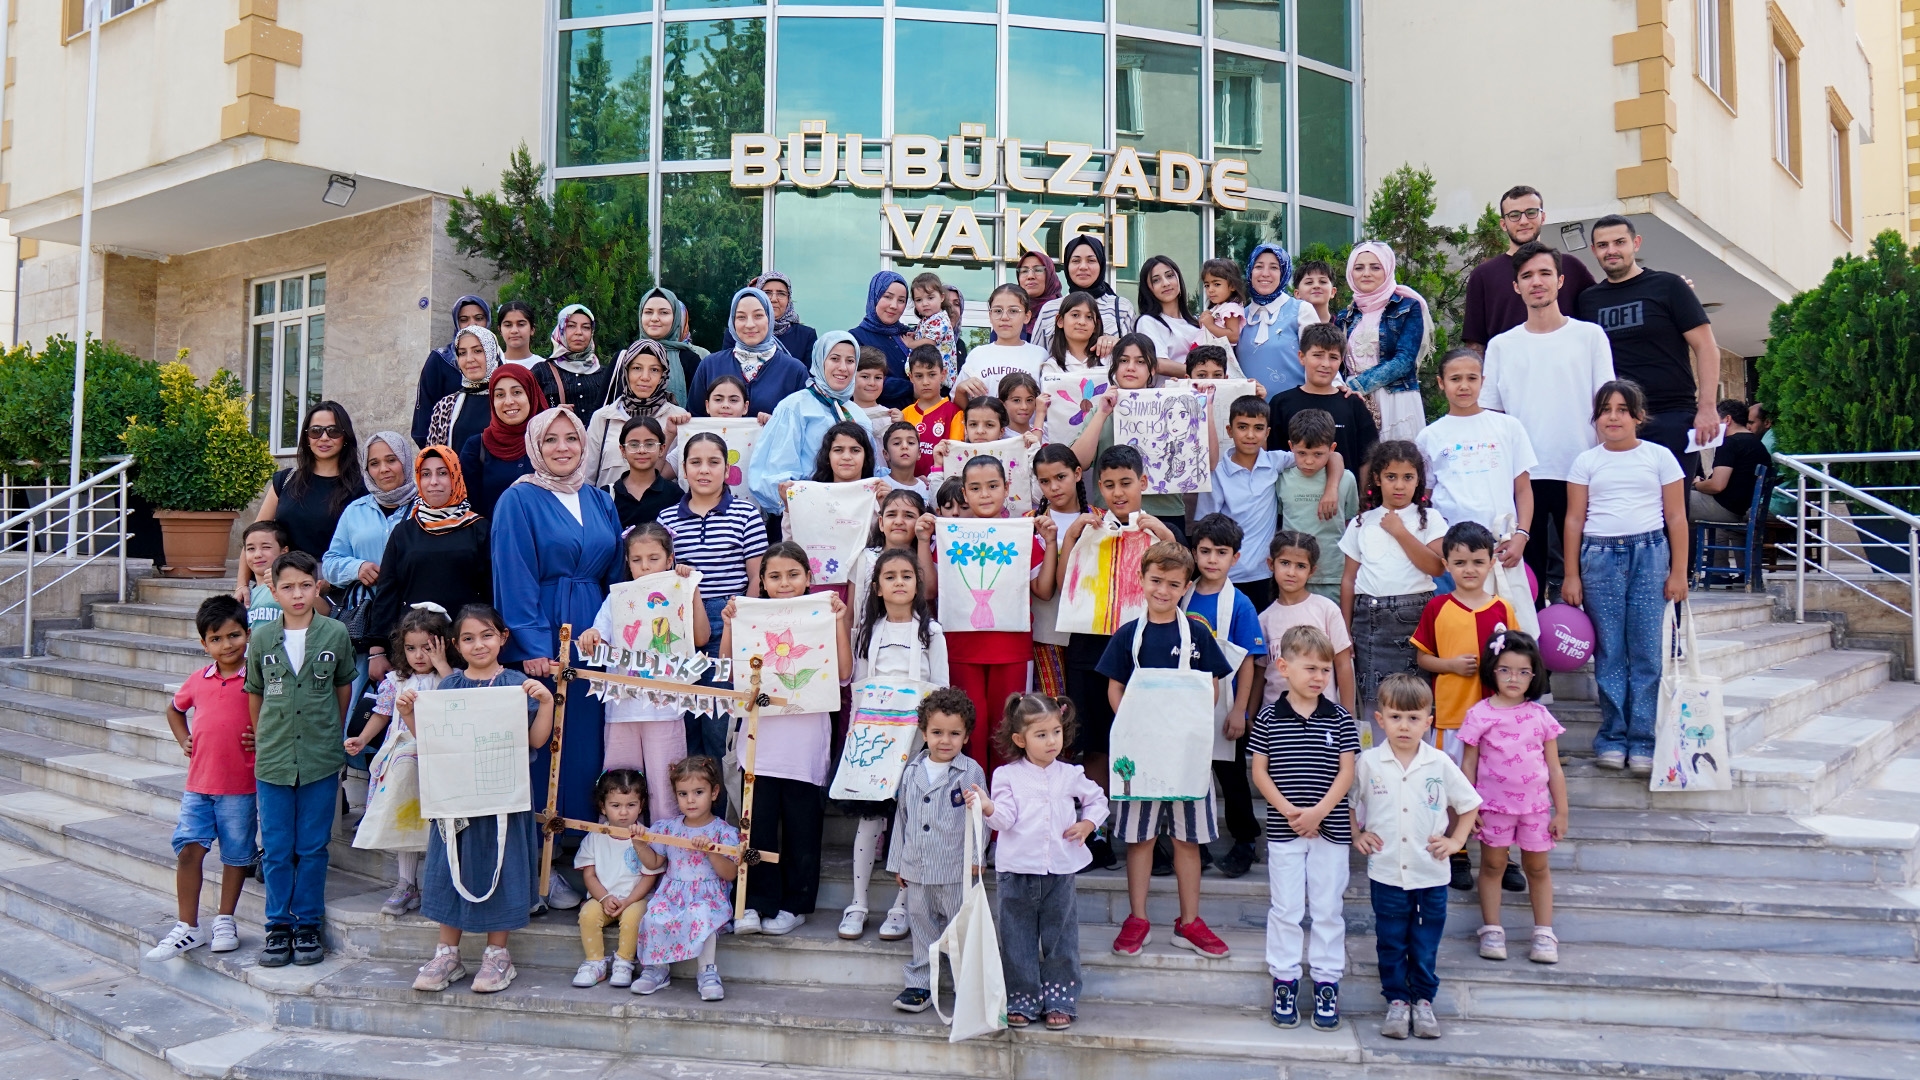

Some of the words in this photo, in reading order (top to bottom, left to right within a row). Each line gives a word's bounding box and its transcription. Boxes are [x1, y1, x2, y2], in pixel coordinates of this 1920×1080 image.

[731, 120, 1248, 211] BÜLBÜLZADE
[1600, 303, 1639, 328] LOFT
[1119, 419, 1163, 435] KOCHO
[1555, 629, 1591, 650] gülelim
[1557, 642, 1569, 654] ki
[1567, 647, 1586, 660] Gül
